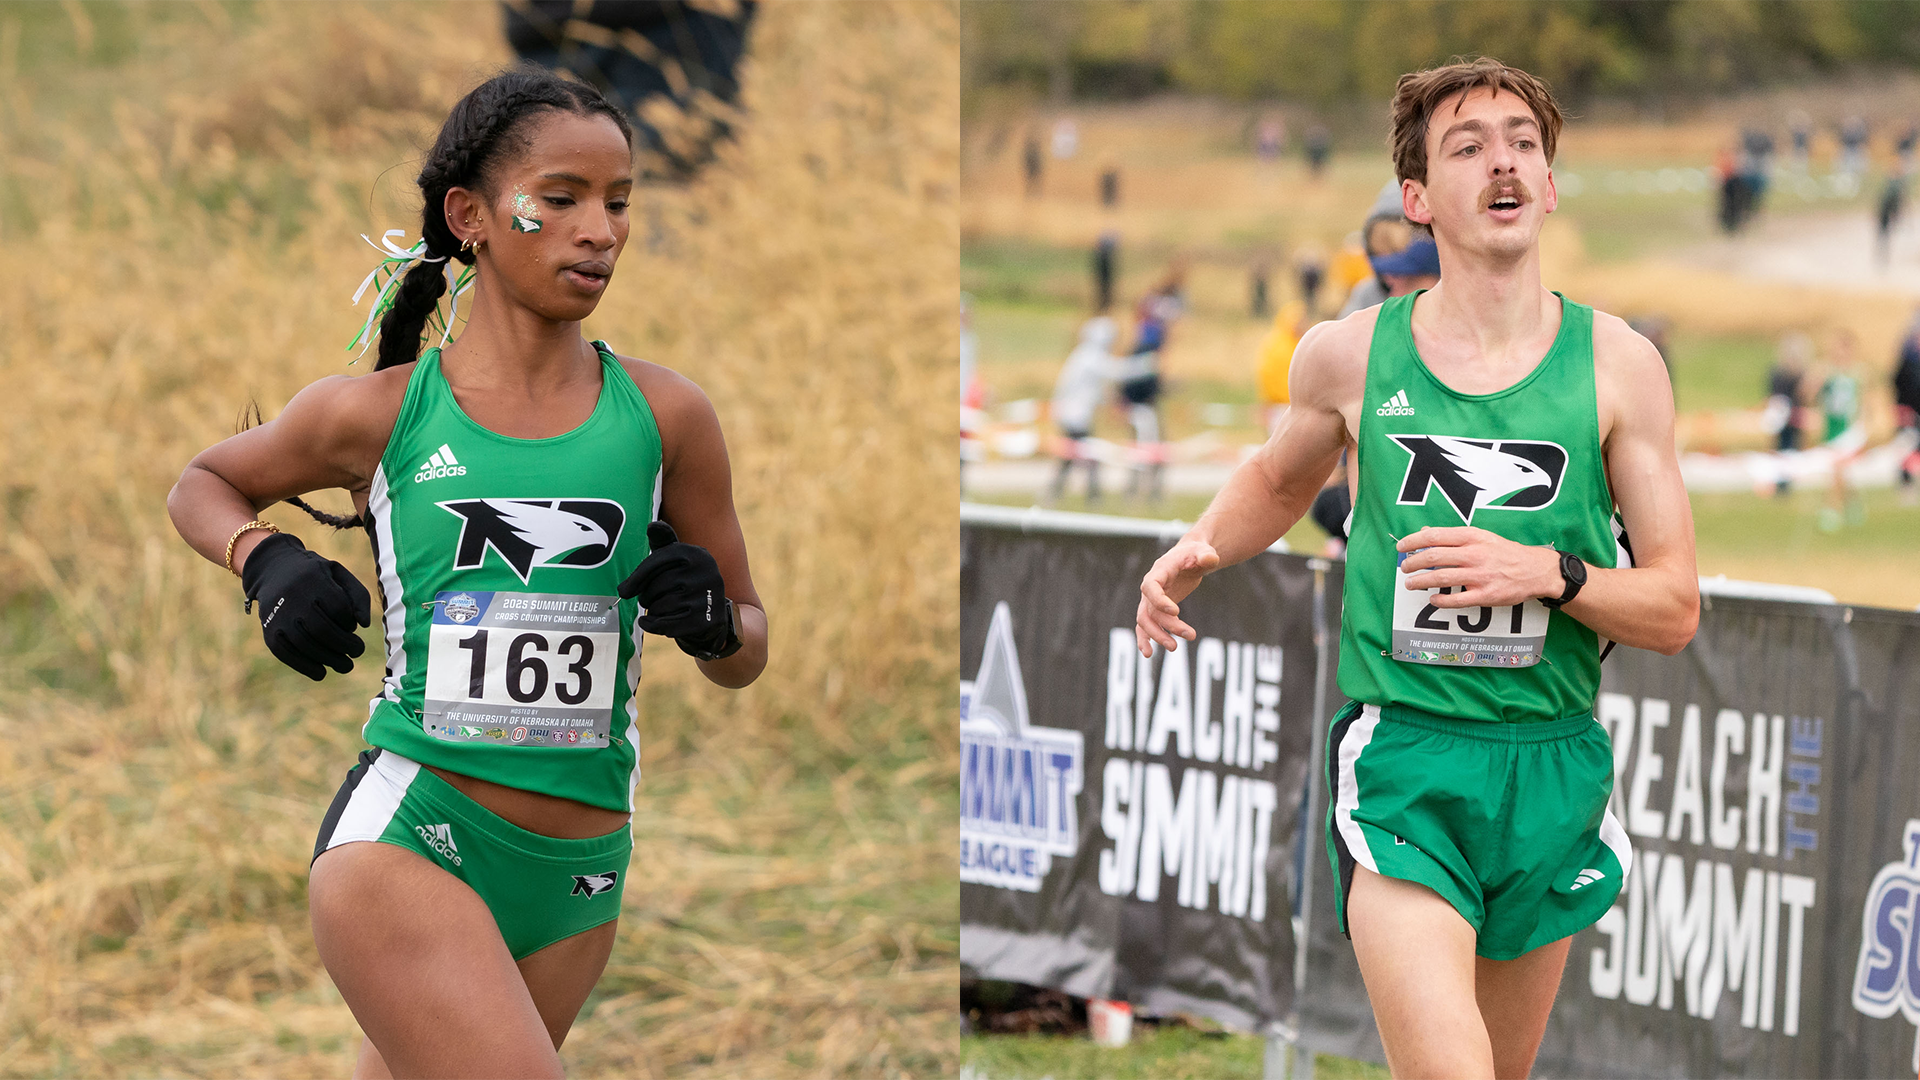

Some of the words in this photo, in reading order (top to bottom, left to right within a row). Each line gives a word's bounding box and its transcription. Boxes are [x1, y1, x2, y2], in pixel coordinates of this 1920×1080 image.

[1376, 405, 1415, 417] adidas
[414, 465, 467, 484] adidas
[263, 597, 285, 628] HEAD
[503, 598, 528, 610] 2025
[530, 599, 567, 611] SUMMIT
[568, 602, 599, 613] LEAGUE
[494, 612, 519, 621] CROSS
[520, 613, 552, 623] COUNTRY
[553, 615, 606, 625] CHAMPIONSHIPS
[1409, 640, 1421, 648] THE
[1421, 640, 1460, 650] UNIVERSITY
[1460, 643, 1469, 651] OF
[1469, 643, 1503, 652] NEBRASKA
[459, 629, 594, 706] 163
[1251, 643, 1284, 772] THE
[446, 711, 461, 721] THE
[462, 712, 508, 724] UNIVERSITY
[509, 716, 520, 725] OF
[520, 716, 559, 727] NEBRASKA
[560, 719, 570, 727] AT
[570, 719, 594, 728] OMAHA
[529, 728, 549, 737] ORU
[1597, 692, 1786, 858] REACH
[1783, 715, 1824, 861] THE
[415, 825, 463, 867] adidas
[1588, 846, 1816, 1038] SUMMIT
